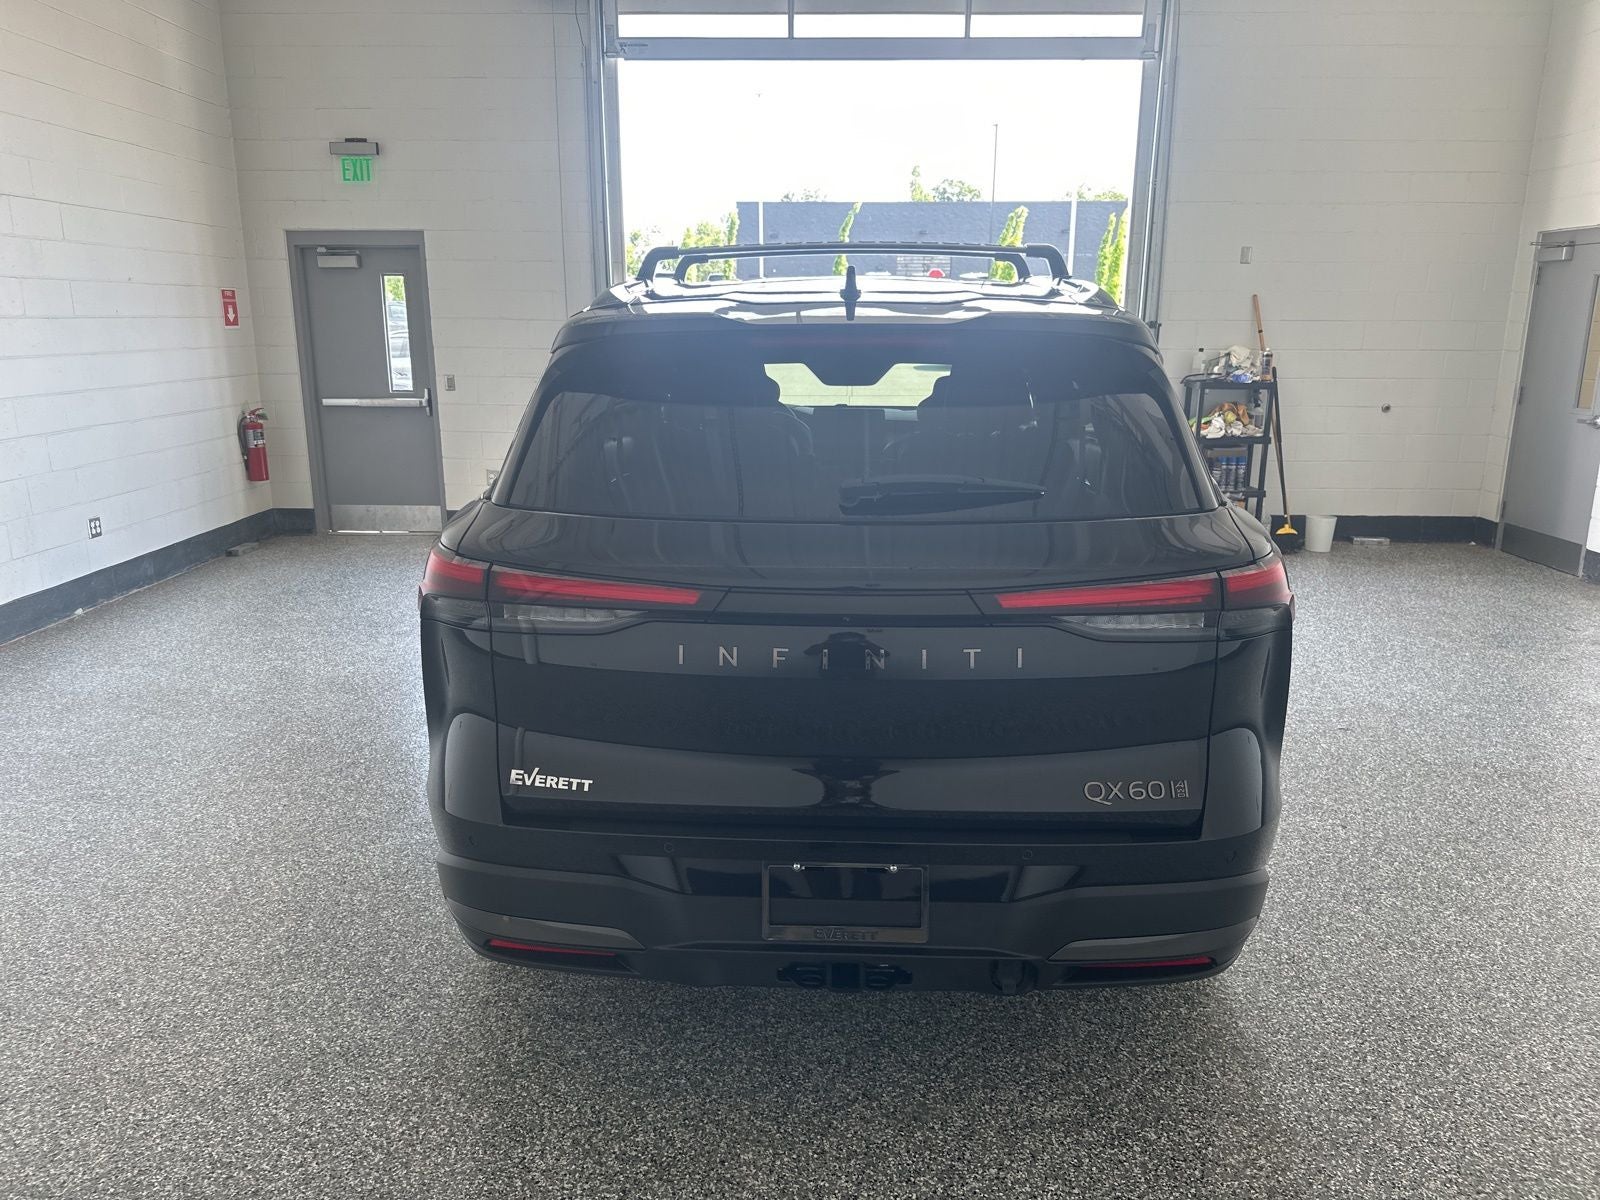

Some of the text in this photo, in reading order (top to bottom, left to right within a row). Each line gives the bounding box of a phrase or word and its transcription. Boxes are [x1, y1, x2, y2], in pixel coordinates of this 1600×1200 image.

[341, 158, 372, 182] EXIT
[678, 644, 1023, 670] INFINITI
[509, 767, 593, 792] EVERETT
